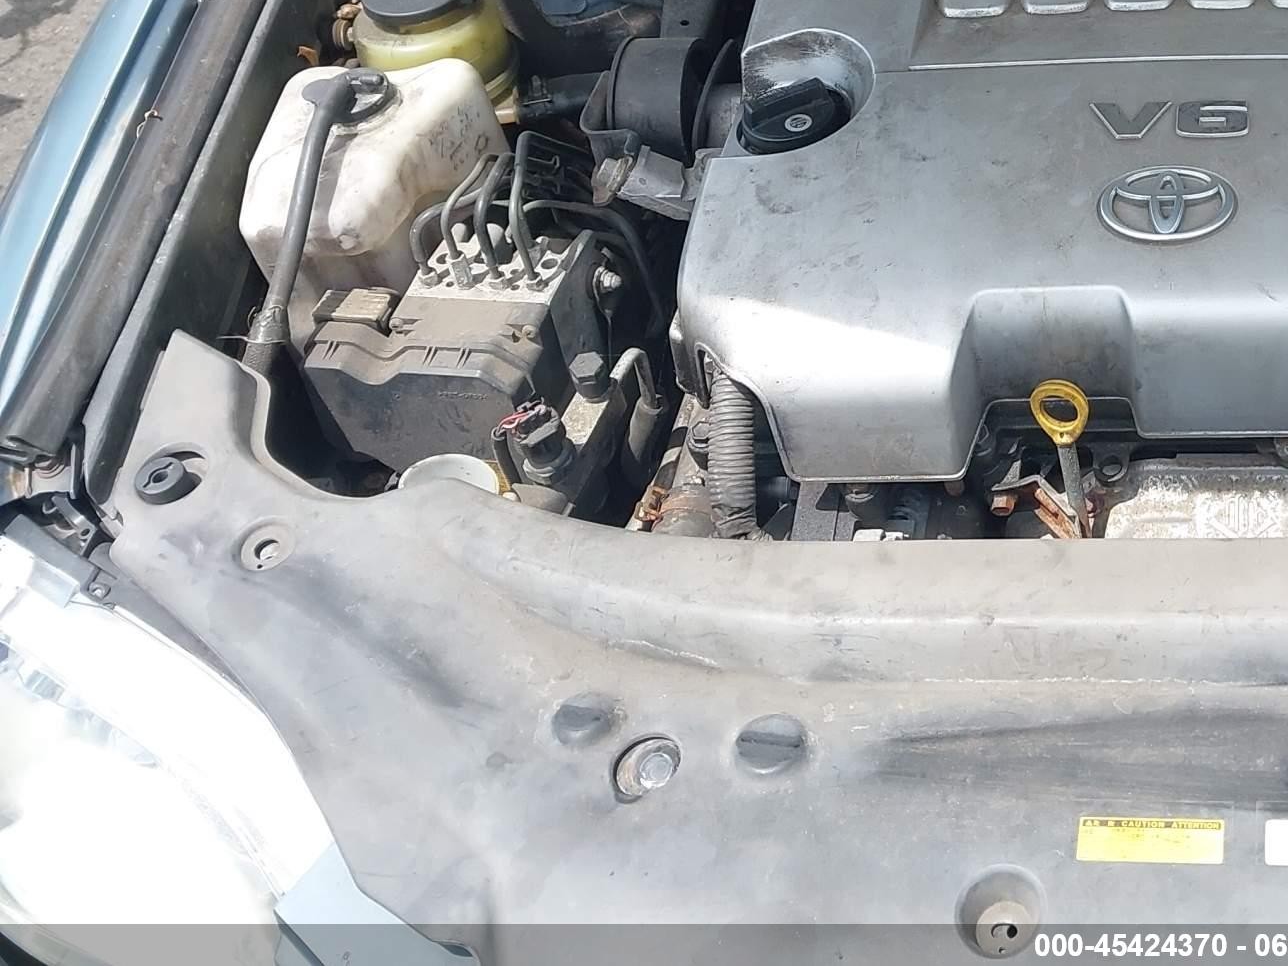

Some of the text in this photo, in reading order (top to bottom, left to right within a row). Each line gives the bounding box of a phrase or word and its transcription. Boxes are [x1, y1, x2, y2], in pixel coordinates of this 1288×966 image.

[1089, 99, 1249, 138] V6
[1122, 820, 1219, 830] CAUTION ATTENTION
